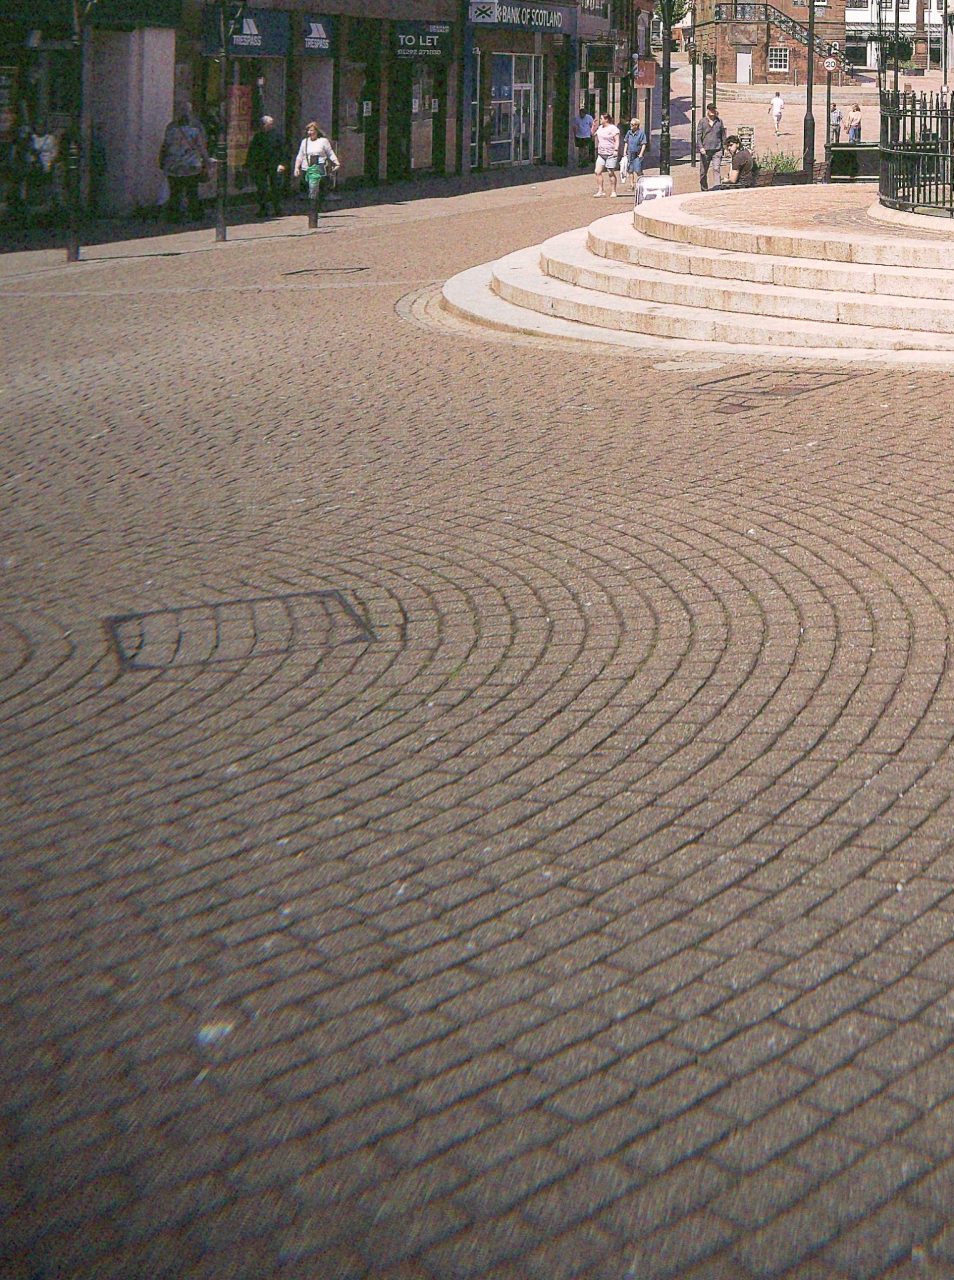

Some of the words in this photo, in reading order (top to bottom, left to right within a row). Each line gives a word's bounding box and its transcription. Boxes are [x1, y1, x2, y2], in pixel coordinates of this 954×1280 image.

[502, 5, 521, 24] BANK
[521, 7, 531, 25] OF
[531, 9, 563, 28] SCOTLAND
[232, 34, 262, 47] TRESPASS
[304, 37, 331, 49] TRESPASS
[398, 34, 416, 46] TO
[419, 35, 439, 46] LET
[825, 60, 836, 68] 20
